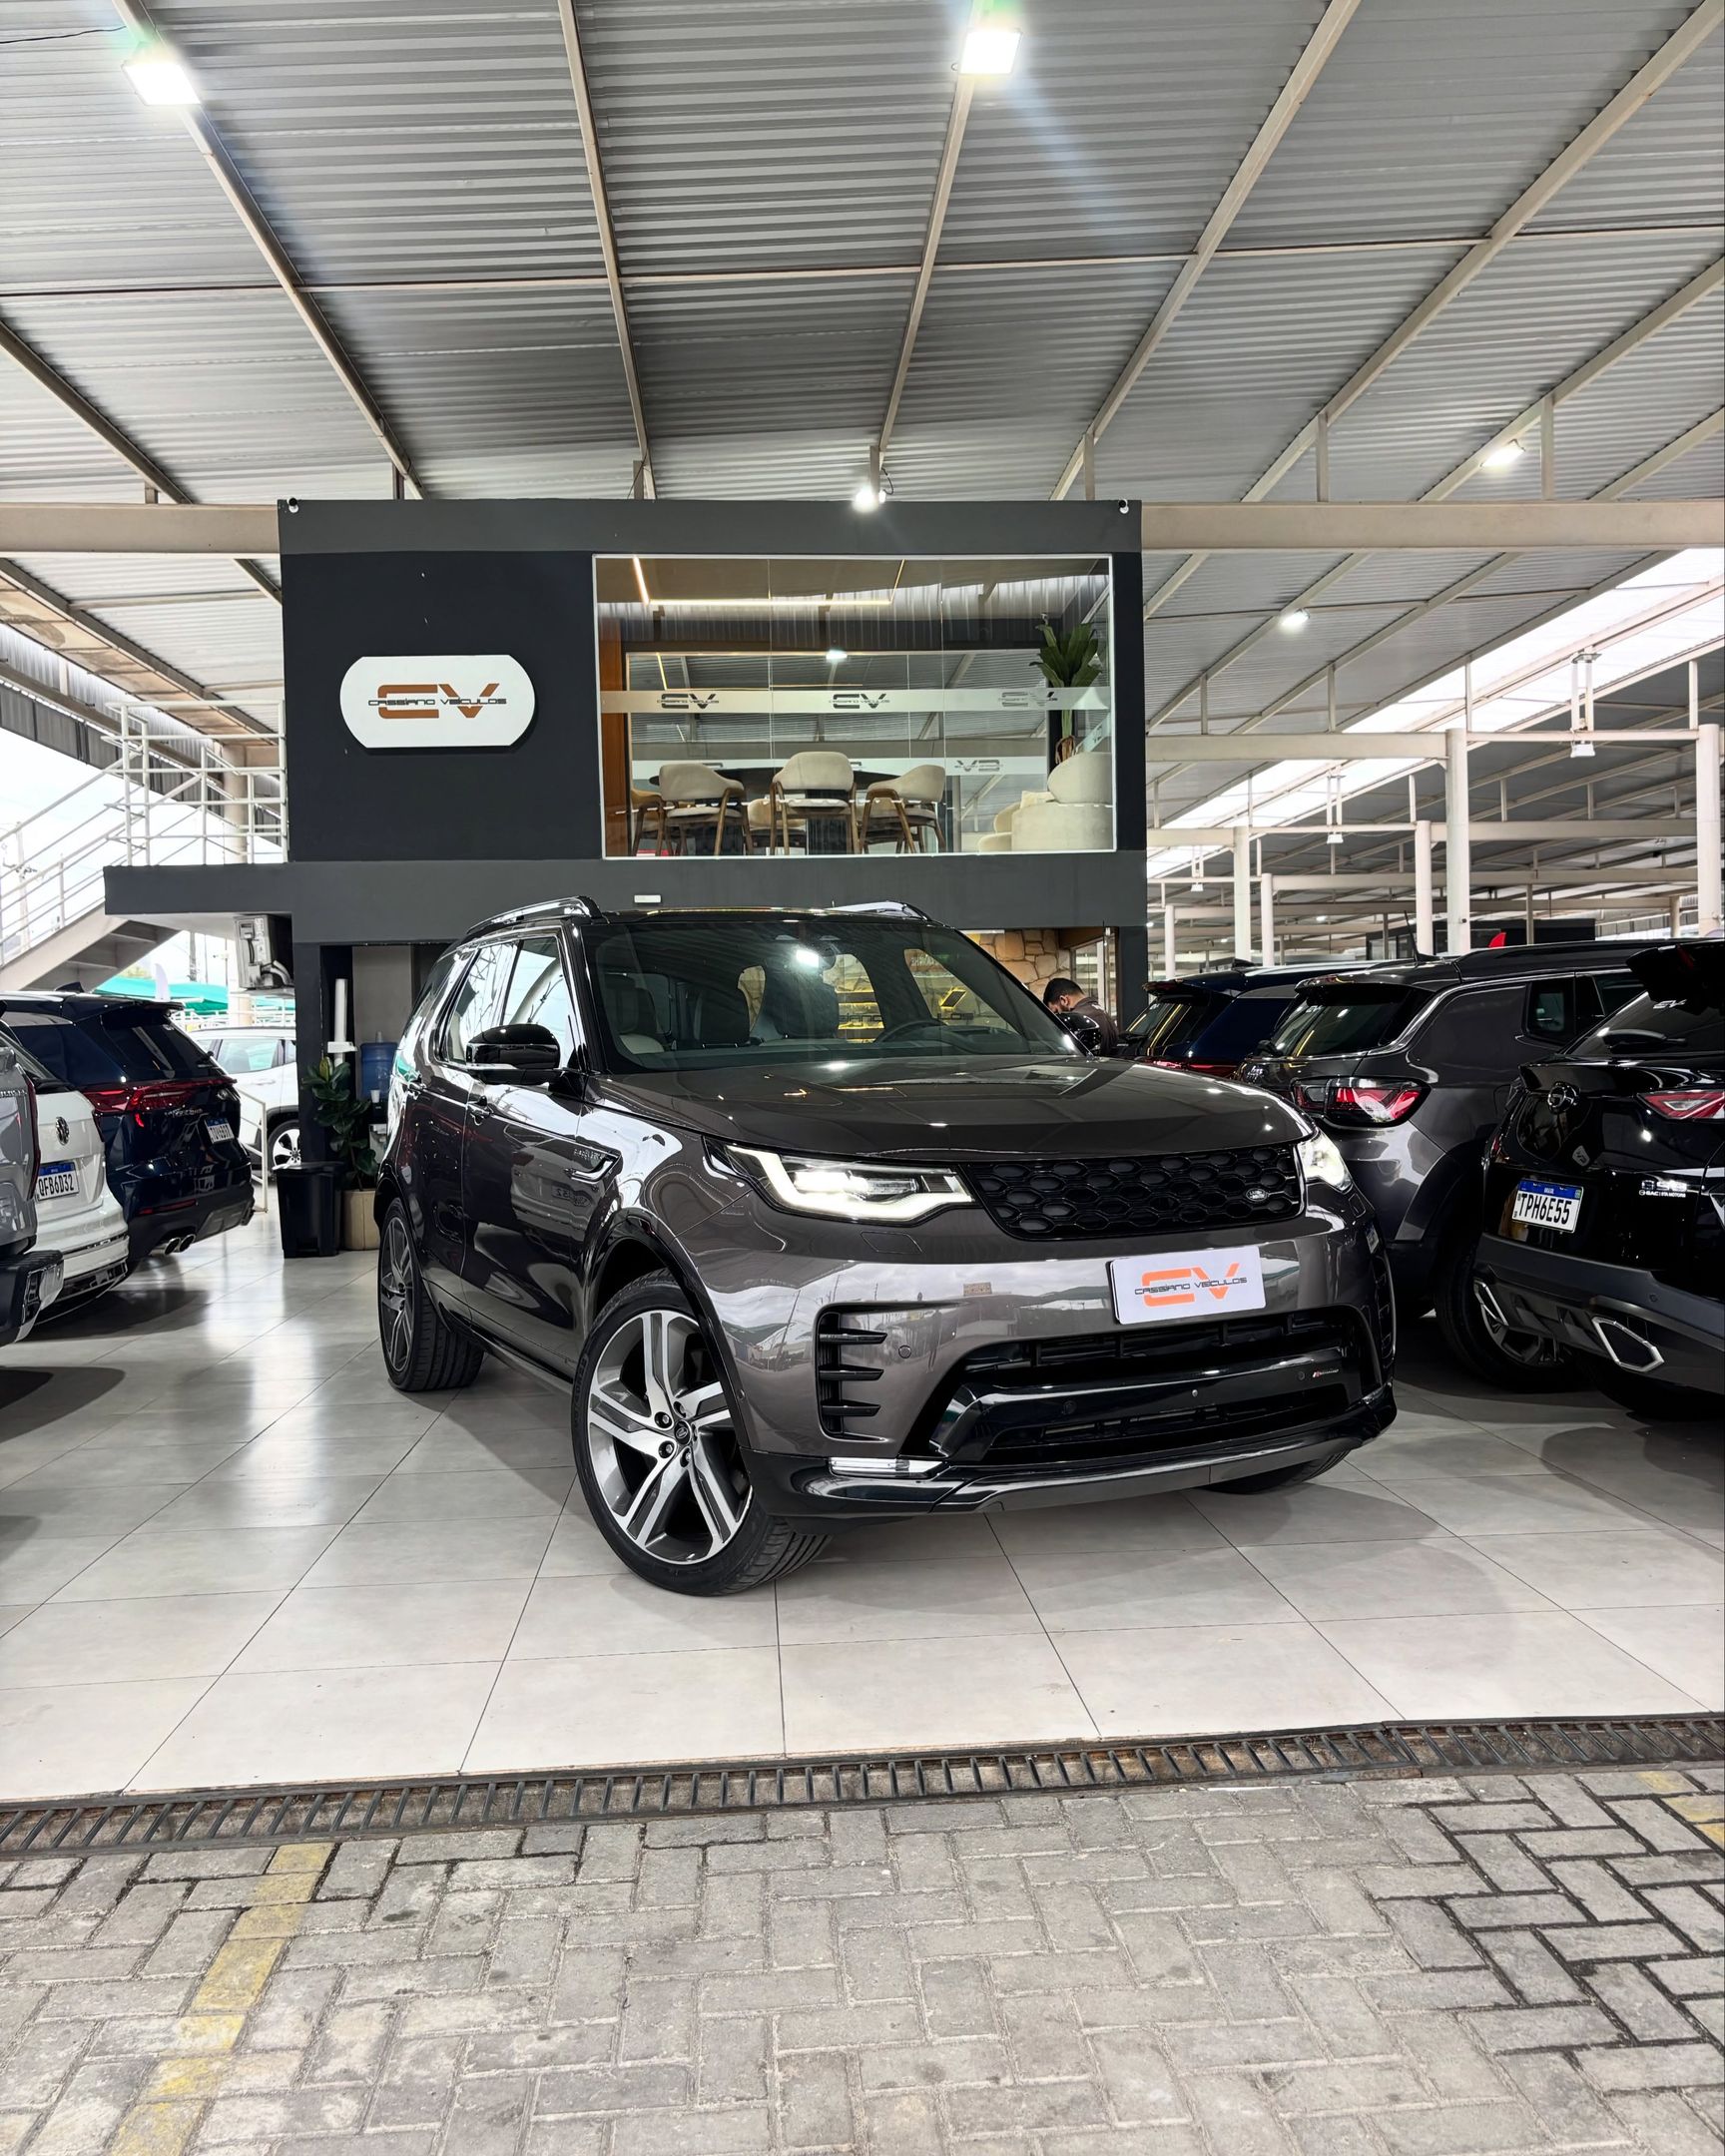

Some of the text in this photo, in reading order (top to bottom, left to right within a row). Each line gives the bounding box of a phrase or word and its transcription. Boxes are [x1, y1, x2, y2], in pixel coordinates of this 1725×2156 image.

[38, 1174, 74, 1197] QFB6D32
[1519, 1193, 1572, 1224] TPH6E55
[1134, 1283, 1191, 1295] CASSIANO
